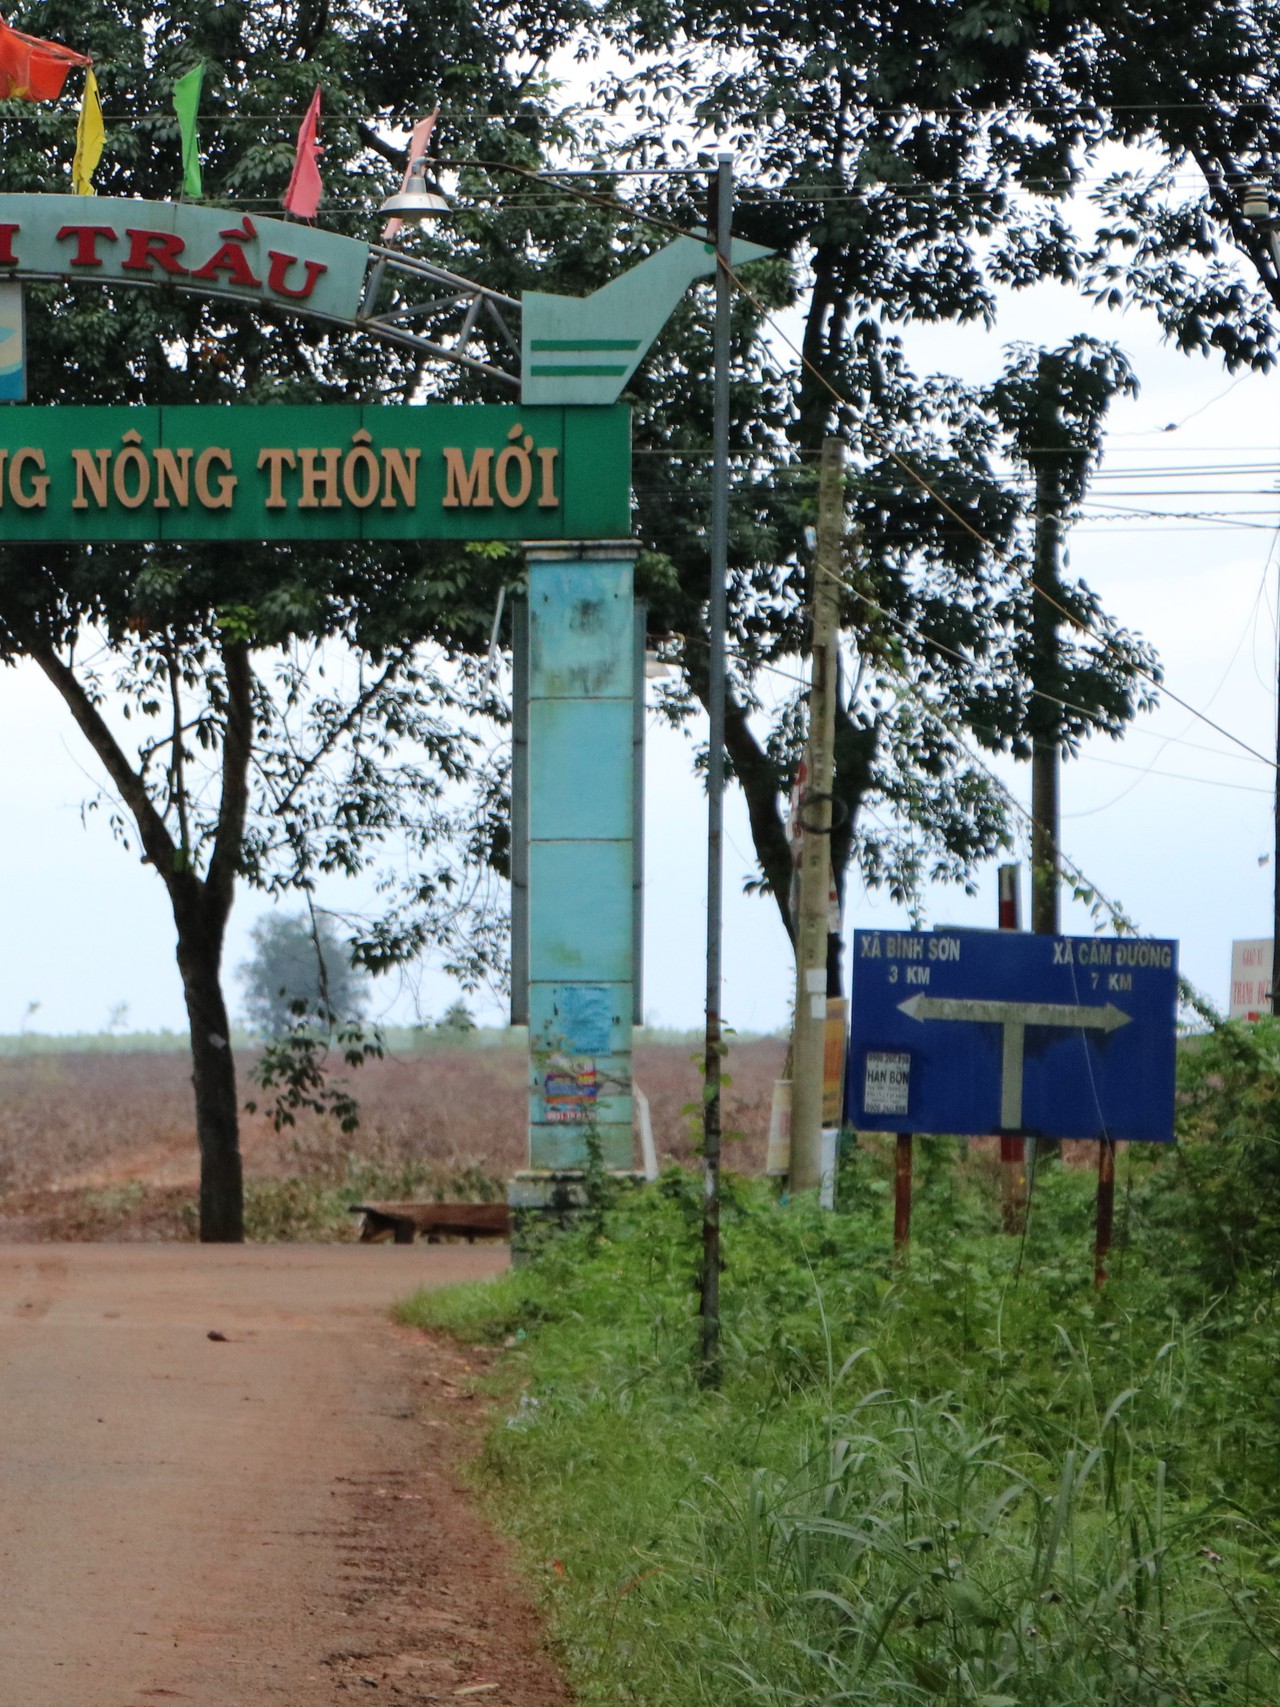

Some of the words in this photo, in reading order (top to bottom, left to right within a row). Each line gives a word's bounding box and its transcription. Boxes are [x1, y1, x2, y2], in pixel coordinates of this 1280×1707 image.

[56, 216, 328, 298] TRẦU
[71, 428, 237, 508] NÔNG
[257, 428, 420, 508] THÔN
[442, 423, 559, 508] MỚI
[861, 932, 881, 958] XÃ
[886, 933, 924, 960] BÌNH
[928, 936, 961, 961] SƠN
[1053, 937, 1074, 965] XÃ
[889, 965, 898, 983] 3
[907, 966, 930, 985] KM
[1091, 972, 1099, 990] 7
[1109, 973, 1132, 991] KM
